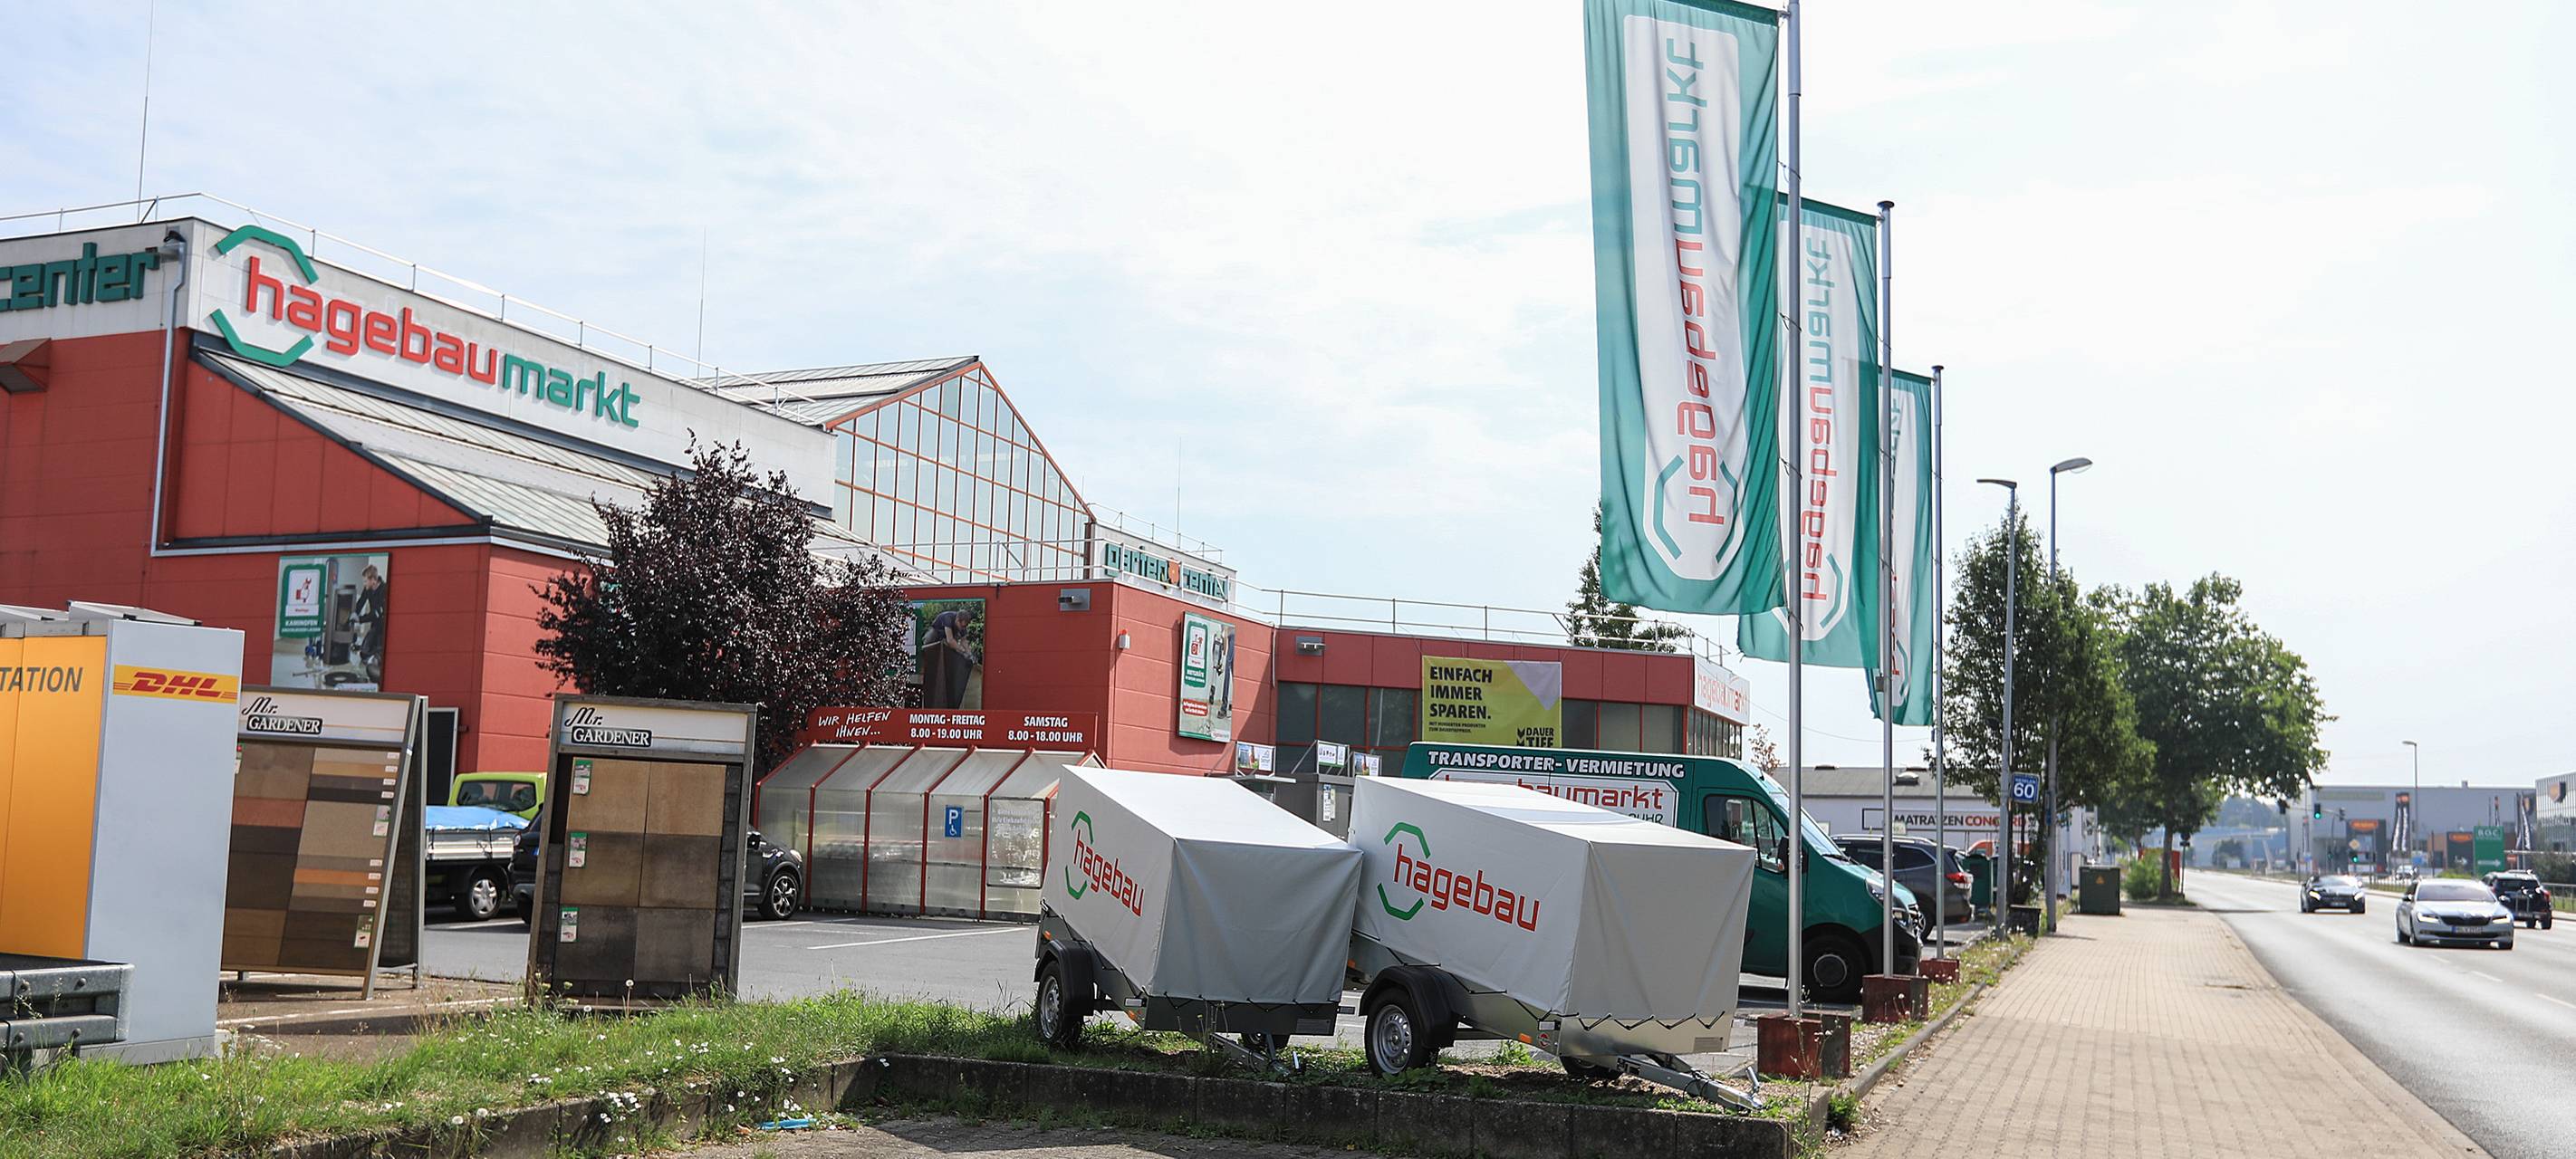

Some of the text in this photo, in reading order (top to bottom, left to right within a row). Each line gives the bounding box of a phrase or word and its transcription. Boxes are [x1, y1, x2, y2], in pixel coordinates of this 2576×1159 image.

[247, 255, 640, 428] hagebaumarkt
[1430, 666, 1493, 683] EINFACH
[130, 671, 223, 698] DHL
[1430, 685, 1482, 701] IMMER
[242, 696, 278, 715] Mr.
[1429, 704, 1491, 720] SPAREN.
[248, 716, 320, 733] GARDENER
[564, 707, 603, 727] Mr.
[818, 710, 891, 727] WIR HELFEN
[908, 714, 946, 724] MONTAG
[951, 714, 985, 725] FREITAG
[1024, 716, 1068, 727] SAMSTAG
[573, 728, 649, 746] GARDENER
[910, 728, 930, 738] 8.00
[937, 728, 961, 739] 19.00
[963, 729, 983, 740] UHR
[1008, 730, 1029, 741] 8.00
[1035, 731, 1061, 742] 18.00
[1062, 732, 1083, 742] UHR
[1525, 727, 1554, 736] DAUER
[1566, 759, 1685, 778] VERMIETUNG
[2014, 782, 2035, 799] 60
[948, 809, 959, 825] P
[1894, 815, 2027, 827] MATRAZEN CONCRD
[1074, 829, 1144, 916] hagebau
[1394, 843, 1539, 932] hagebau
